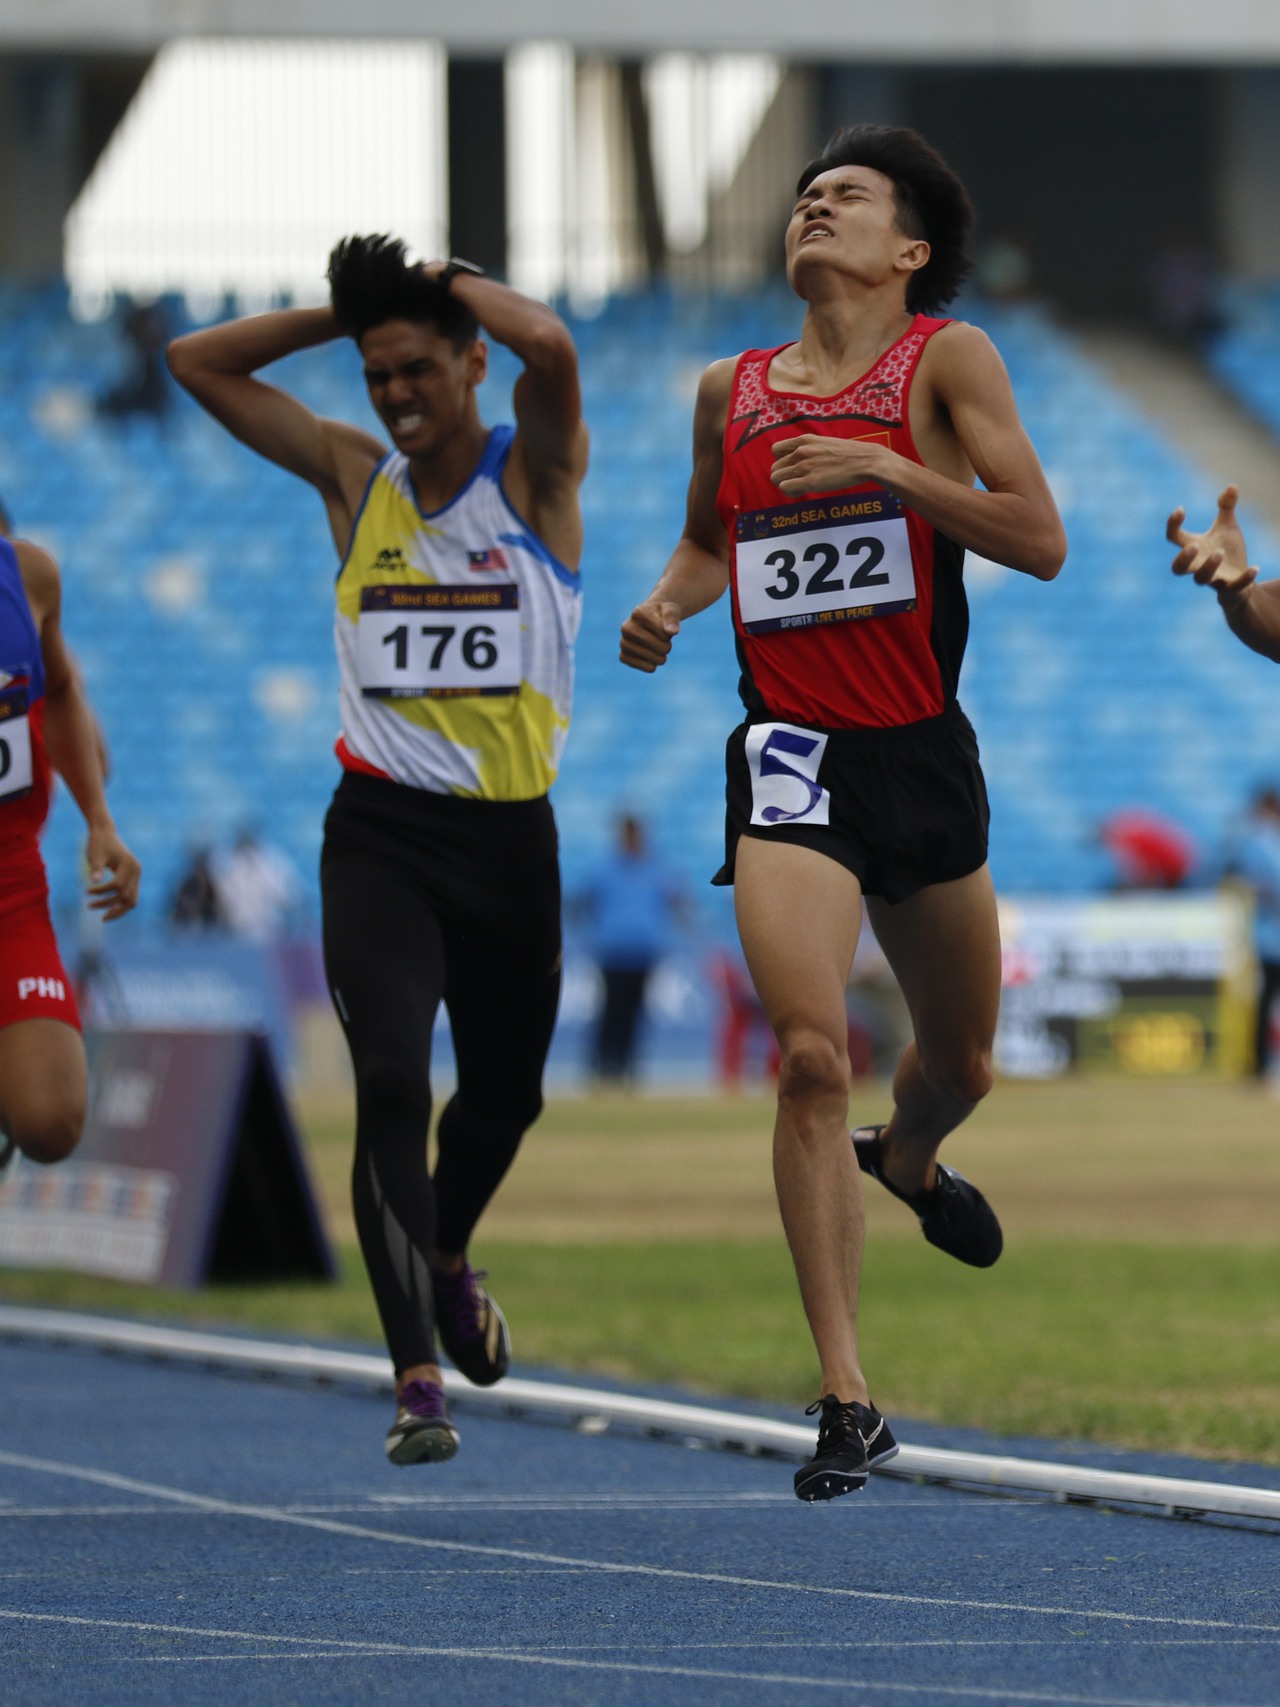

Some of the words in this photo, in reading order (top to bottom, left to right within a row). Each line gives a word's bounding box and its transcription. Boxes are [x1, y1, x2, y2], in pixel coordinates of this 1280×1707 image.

[771, 513, 799, 529] 32nd
[801, 509, 827, 524] SEA
[829, 501, 883, 518] GAMES
[763, 536, 890, 601] 322
[424, 591, 449, 606] SEA
[451, 590, 501, 606] GAMES
[780, 614, 812, 629] SPORTS
[815, 610, 834, 624] LIVE
[835, 608, 846, 621] IN
[847, 605, 875, 620] PEACE
[382, 625, 498, 671] 176
[759, 728, 823, 823] 5
[17, 976, 66, 1001] PHI
